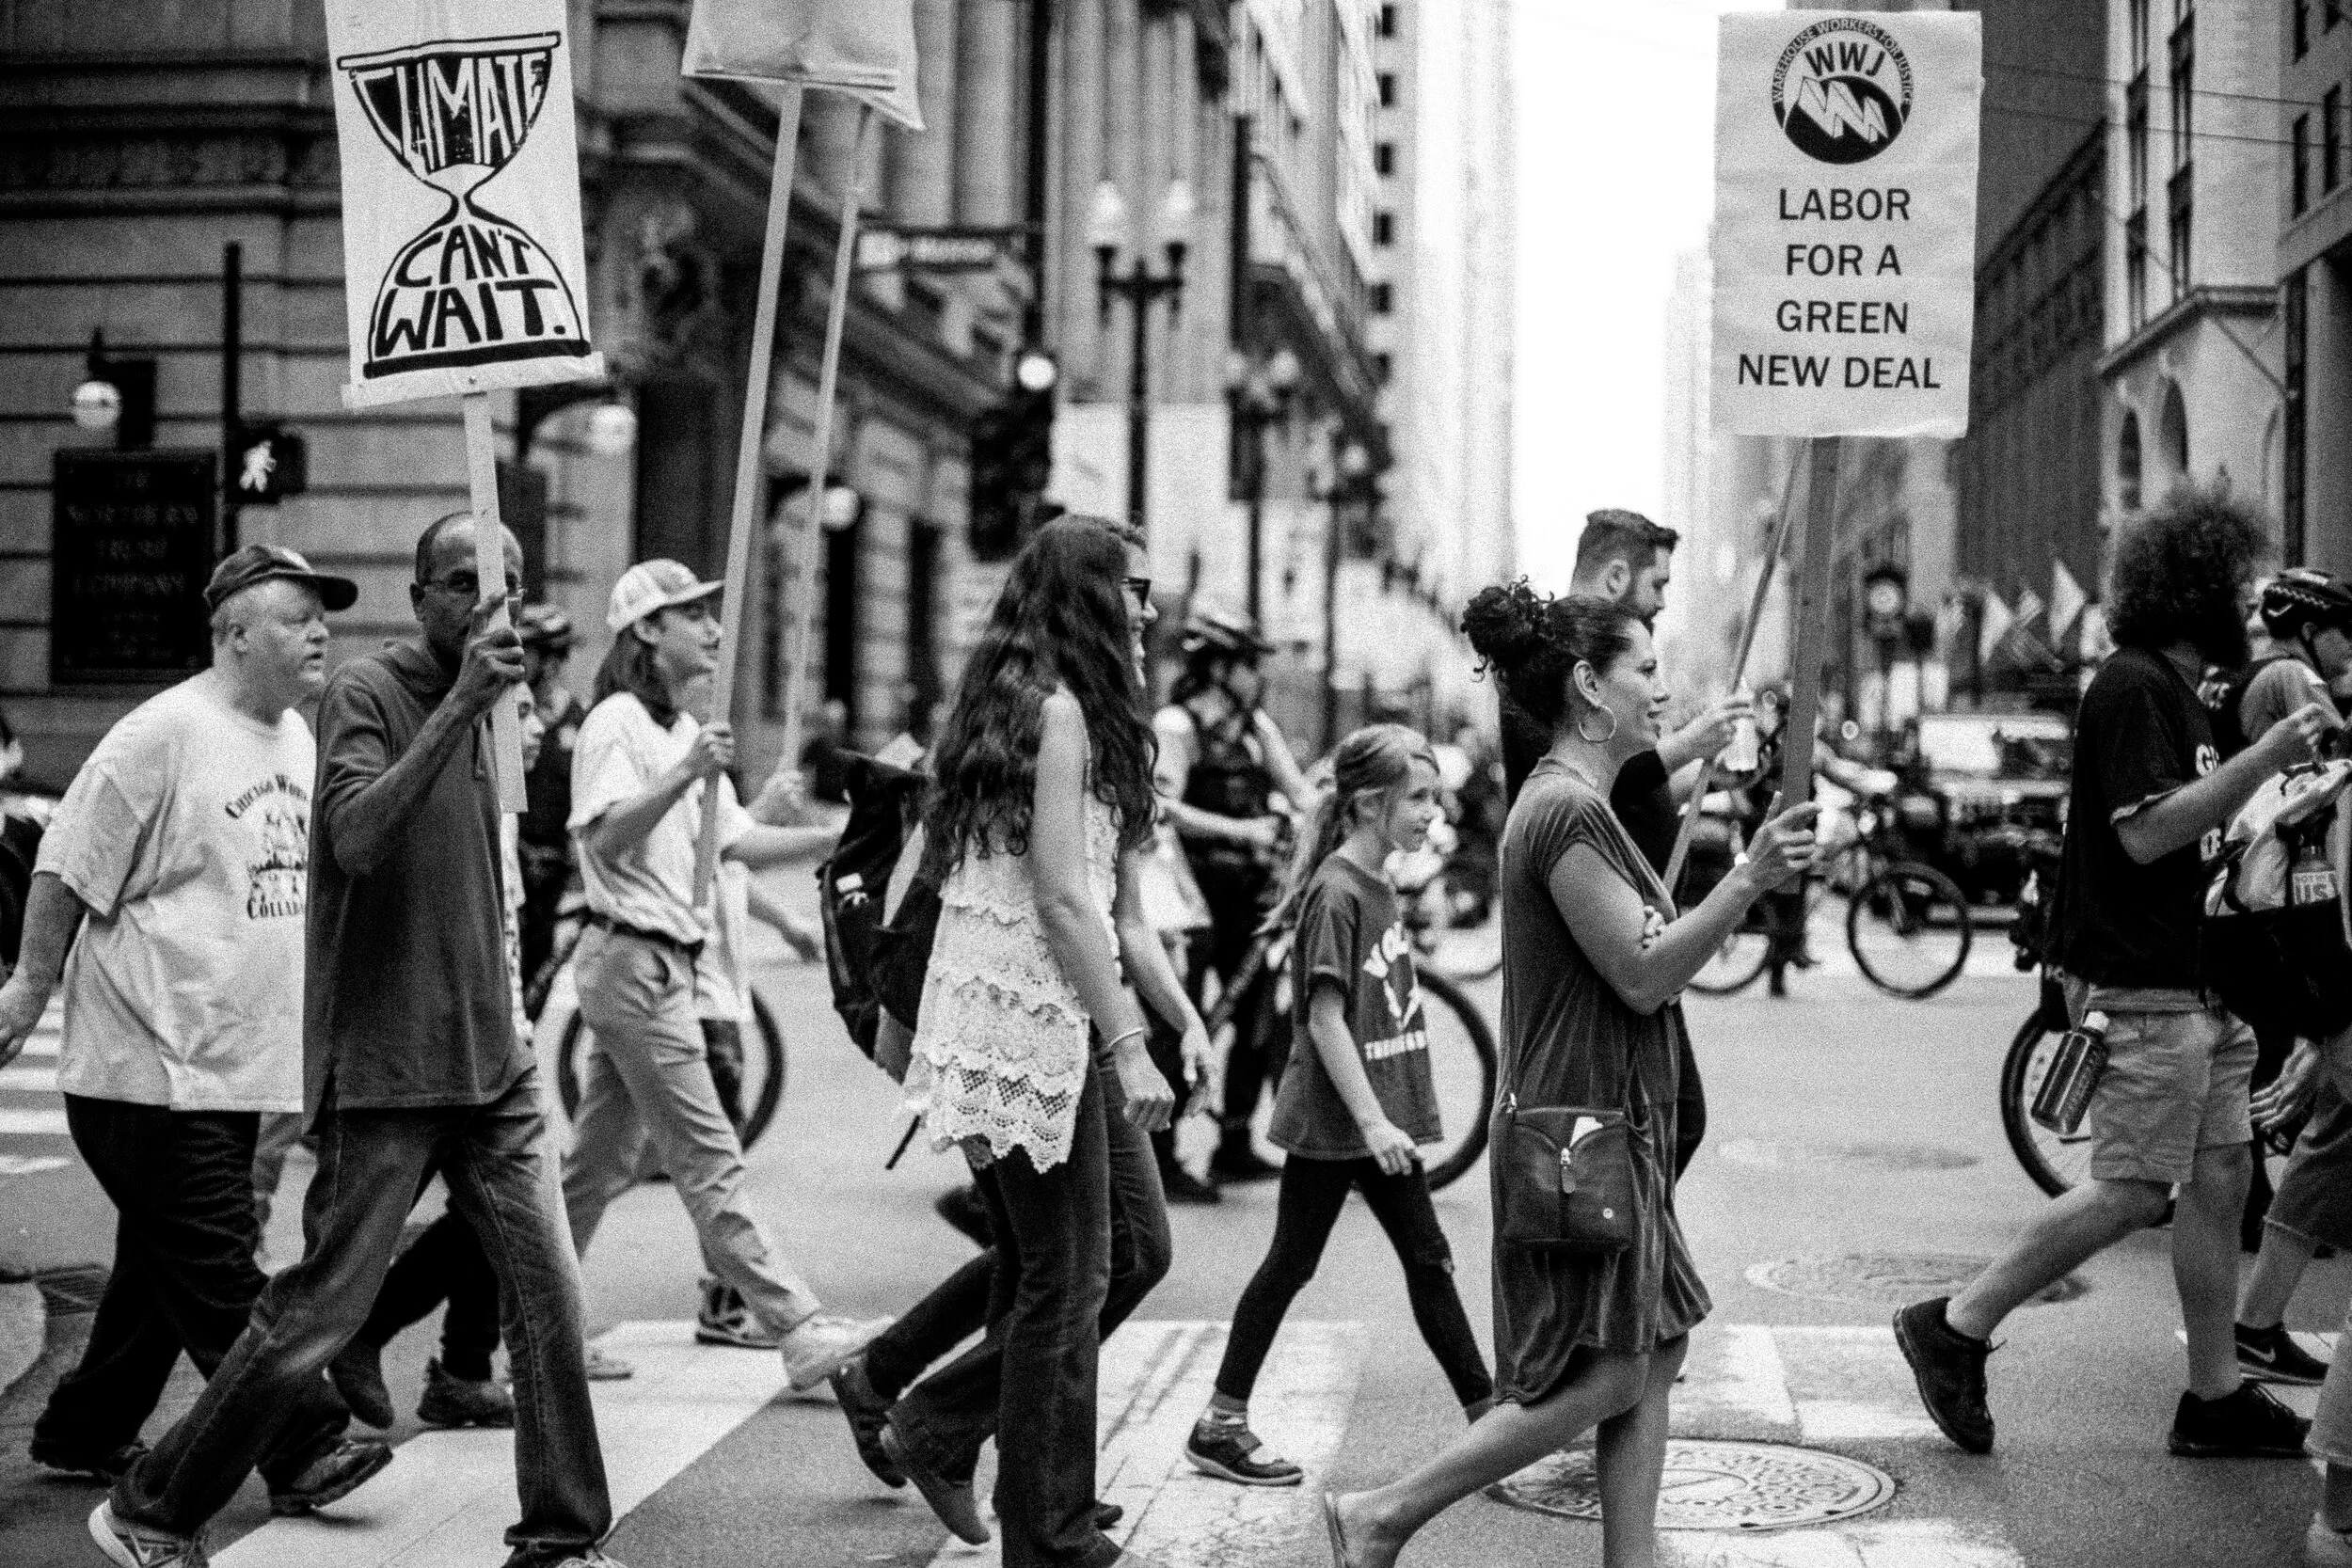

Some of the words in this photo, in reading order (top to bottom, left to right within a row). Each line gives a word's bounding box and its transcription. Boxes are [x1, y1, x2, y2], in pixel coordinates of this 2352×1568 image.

[1772, 28, 1817, 103] WAREHOUSE
[1818, 18, 1880, 38] WORKERS
[1878, 29, 1899, 55] FOR
[1804, 41, 1885, 77] WWJ
[352, 51, 548, 179] CLIMATE
[1779, 187, 1911, 221] LABOR
[394, 224, 531, 288] CAN'T
[1787, 244, 1864, 276] FOR
[1876, 244, 1902, 276] A
[374, 279, 566, 358] WAIT.
[1776, 300, 1909, 334] GREEN
[1738, 354, 1831, 388] NEW
[1844, 356, 1942, 389] DEAL
